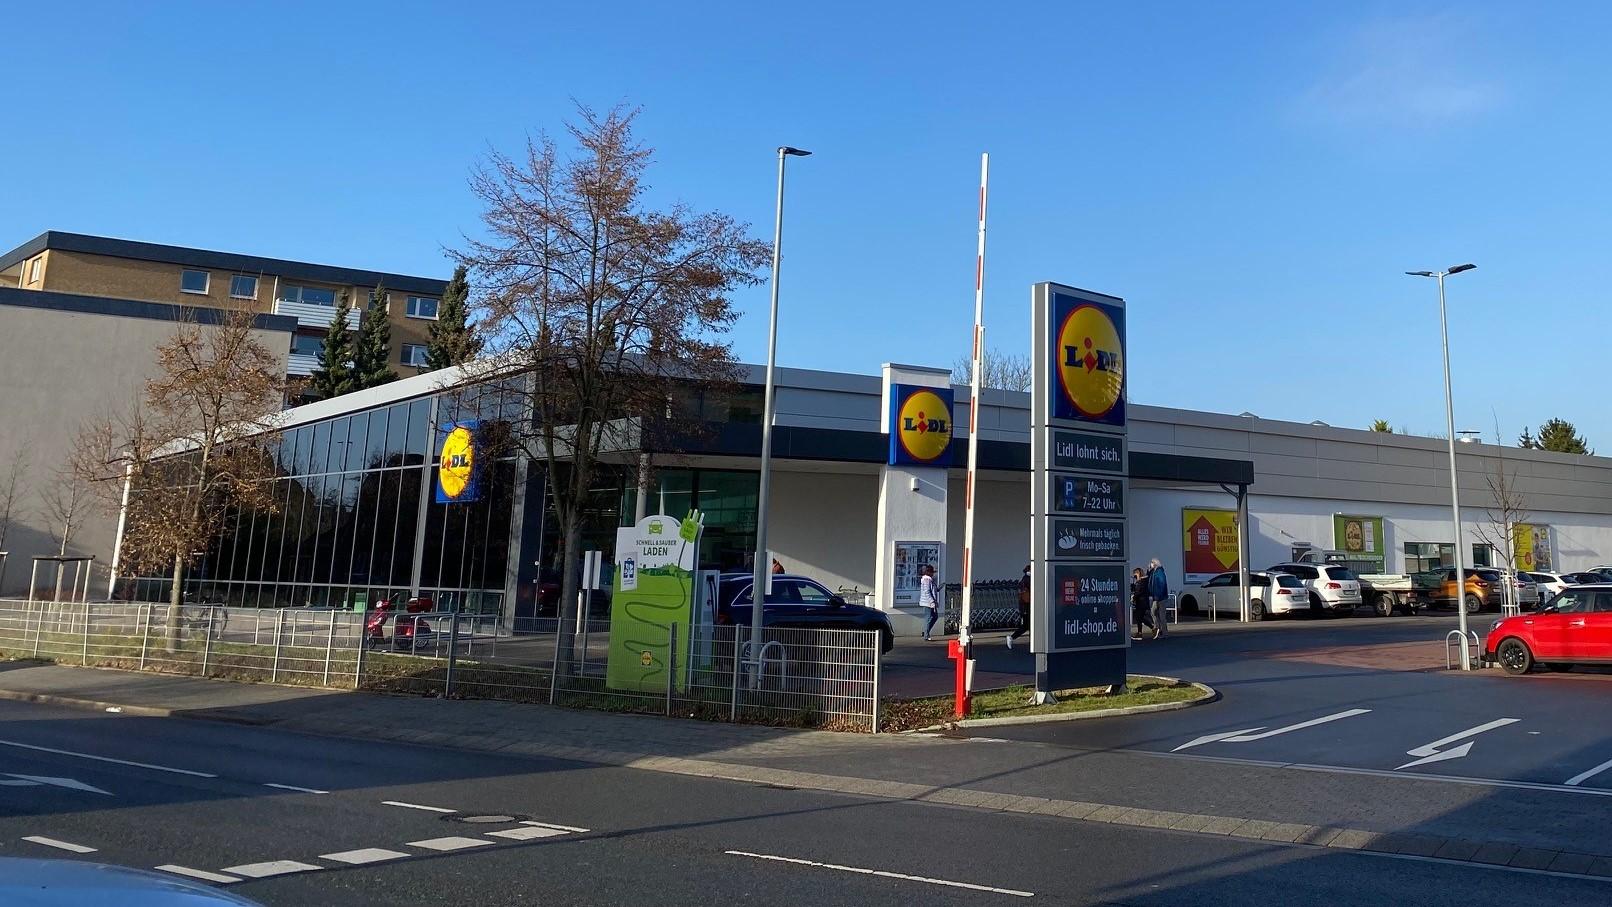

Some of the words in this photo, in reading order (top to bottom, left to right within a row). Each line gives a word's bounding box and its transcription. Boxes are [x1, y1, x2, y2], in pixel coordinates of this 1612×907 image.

[1057, 442, 1073, 457] Lidl
[1077, 444, 1098, 460] lohnt
[1101, 447, 1120, 462] sich.
[1065, 481, 1073, 496] P
[1102, 498, 1116, 510] Uhr
[1080, 527, 1103, 538] Mehrmals
[1103, 528, 1120, 540] täglich
[1080, 539, 1094, 550] frisch
[643, 547, 668, 556] LADEN
[1080, 578, 1090, 592] 24
[1091, 578, 1118, 591] Stunden
[1080, 594, 1097, 604] online
[1064, 617, 1118, 637] lidl-shop.de
